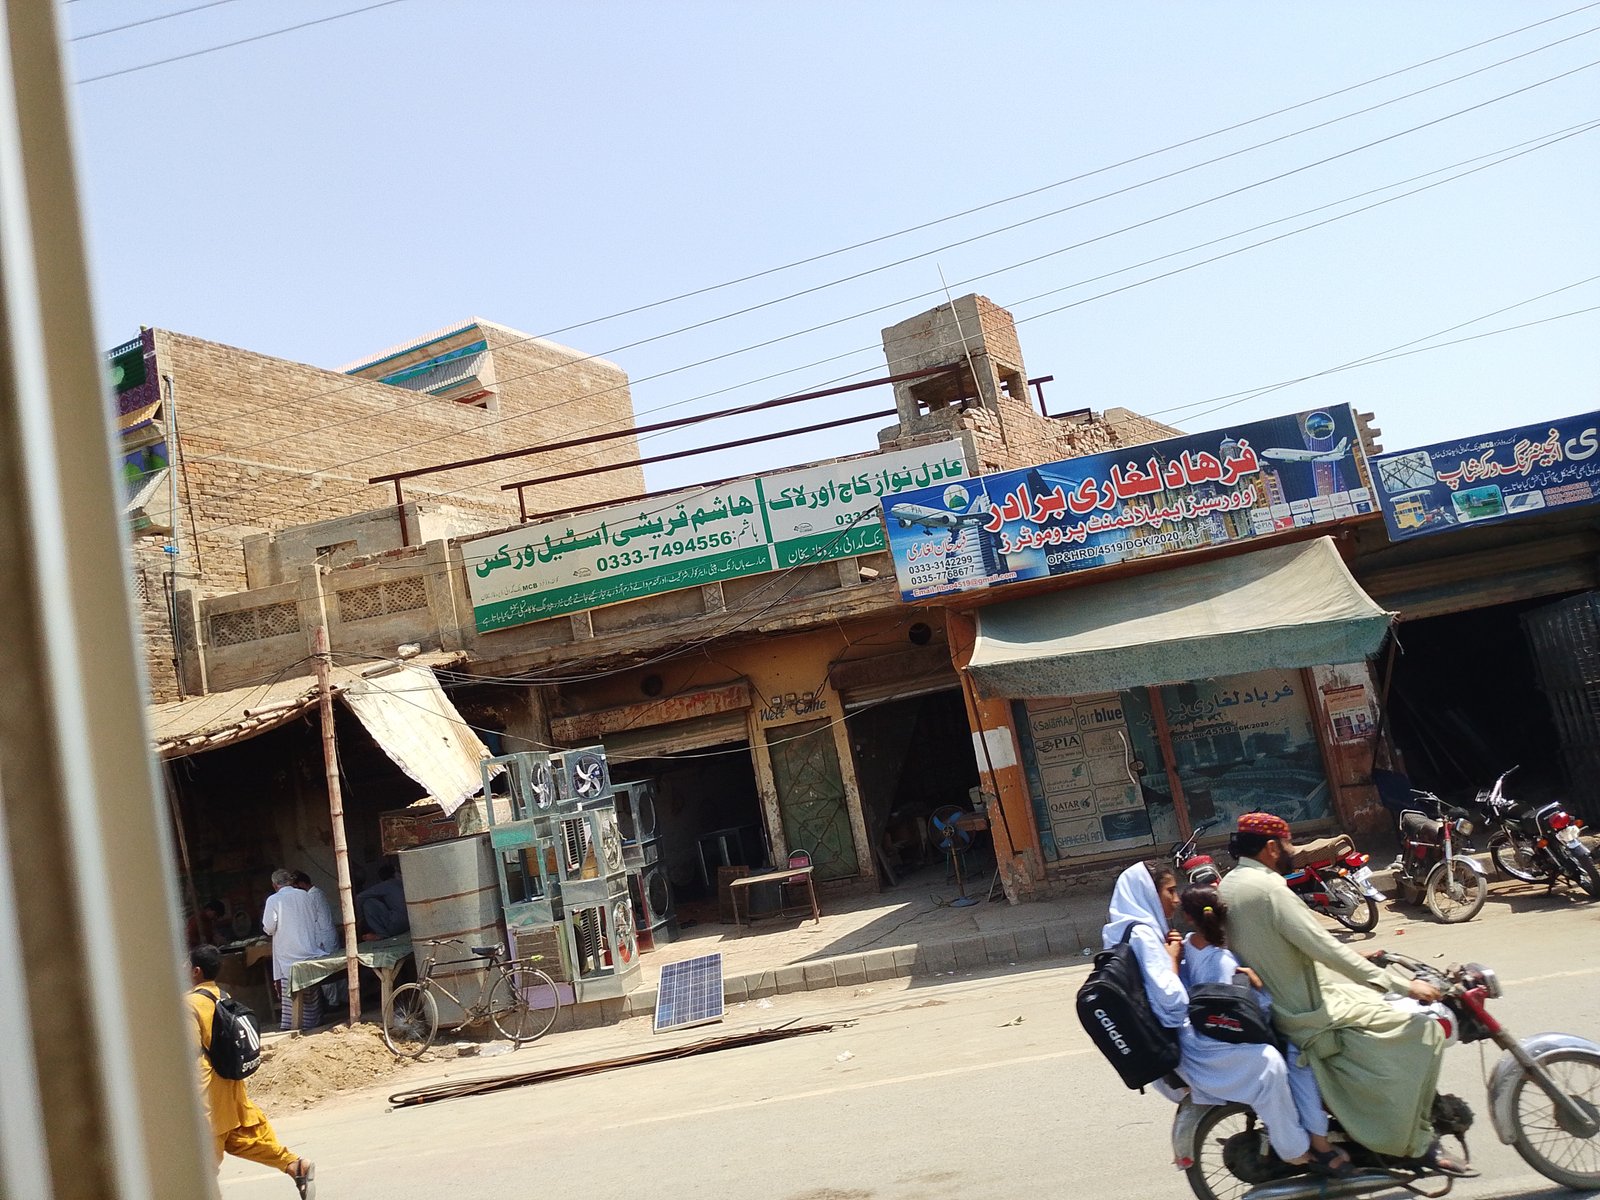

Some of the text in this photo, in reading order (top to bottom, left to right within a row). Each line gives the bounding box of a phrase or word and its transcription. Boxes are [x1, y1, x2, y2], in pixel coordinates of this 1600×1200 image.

[769, 458, 963, 510] عادل نواز کاج اور لاک
[1069, 457, 1163, 511] لغاری
[983, 483, 1067, 533] برادر
[613, 504, 688, 547] قریشی
[538, 522, 609, 563] اسٹیل
[597, 531, 732, 572] 0333-7494556
[907, 540, 934, 560] لغاری
[936, 536, 956, 556] خان
[1047, 532, 1179, 565] OP&HRD/4519/DGK/2020
[476, 544, 536, 577] ورکس
[909, 555, 973, 574] 0333-3142299
[911, 565, 975, 585] 0335-7768677
[522, 582, 538, 591] MCB
[1039, 715, 1075, 731] SalamAir
[1080, 708, 1122, 726] airblue
[1054, 736, 1079, 749] PIA
[1051, 800, 1080, 813] QATAR
[1058, 832, 1089, 846] SHAHEEN
[1094, 1008, 1132, 1056] adidas
